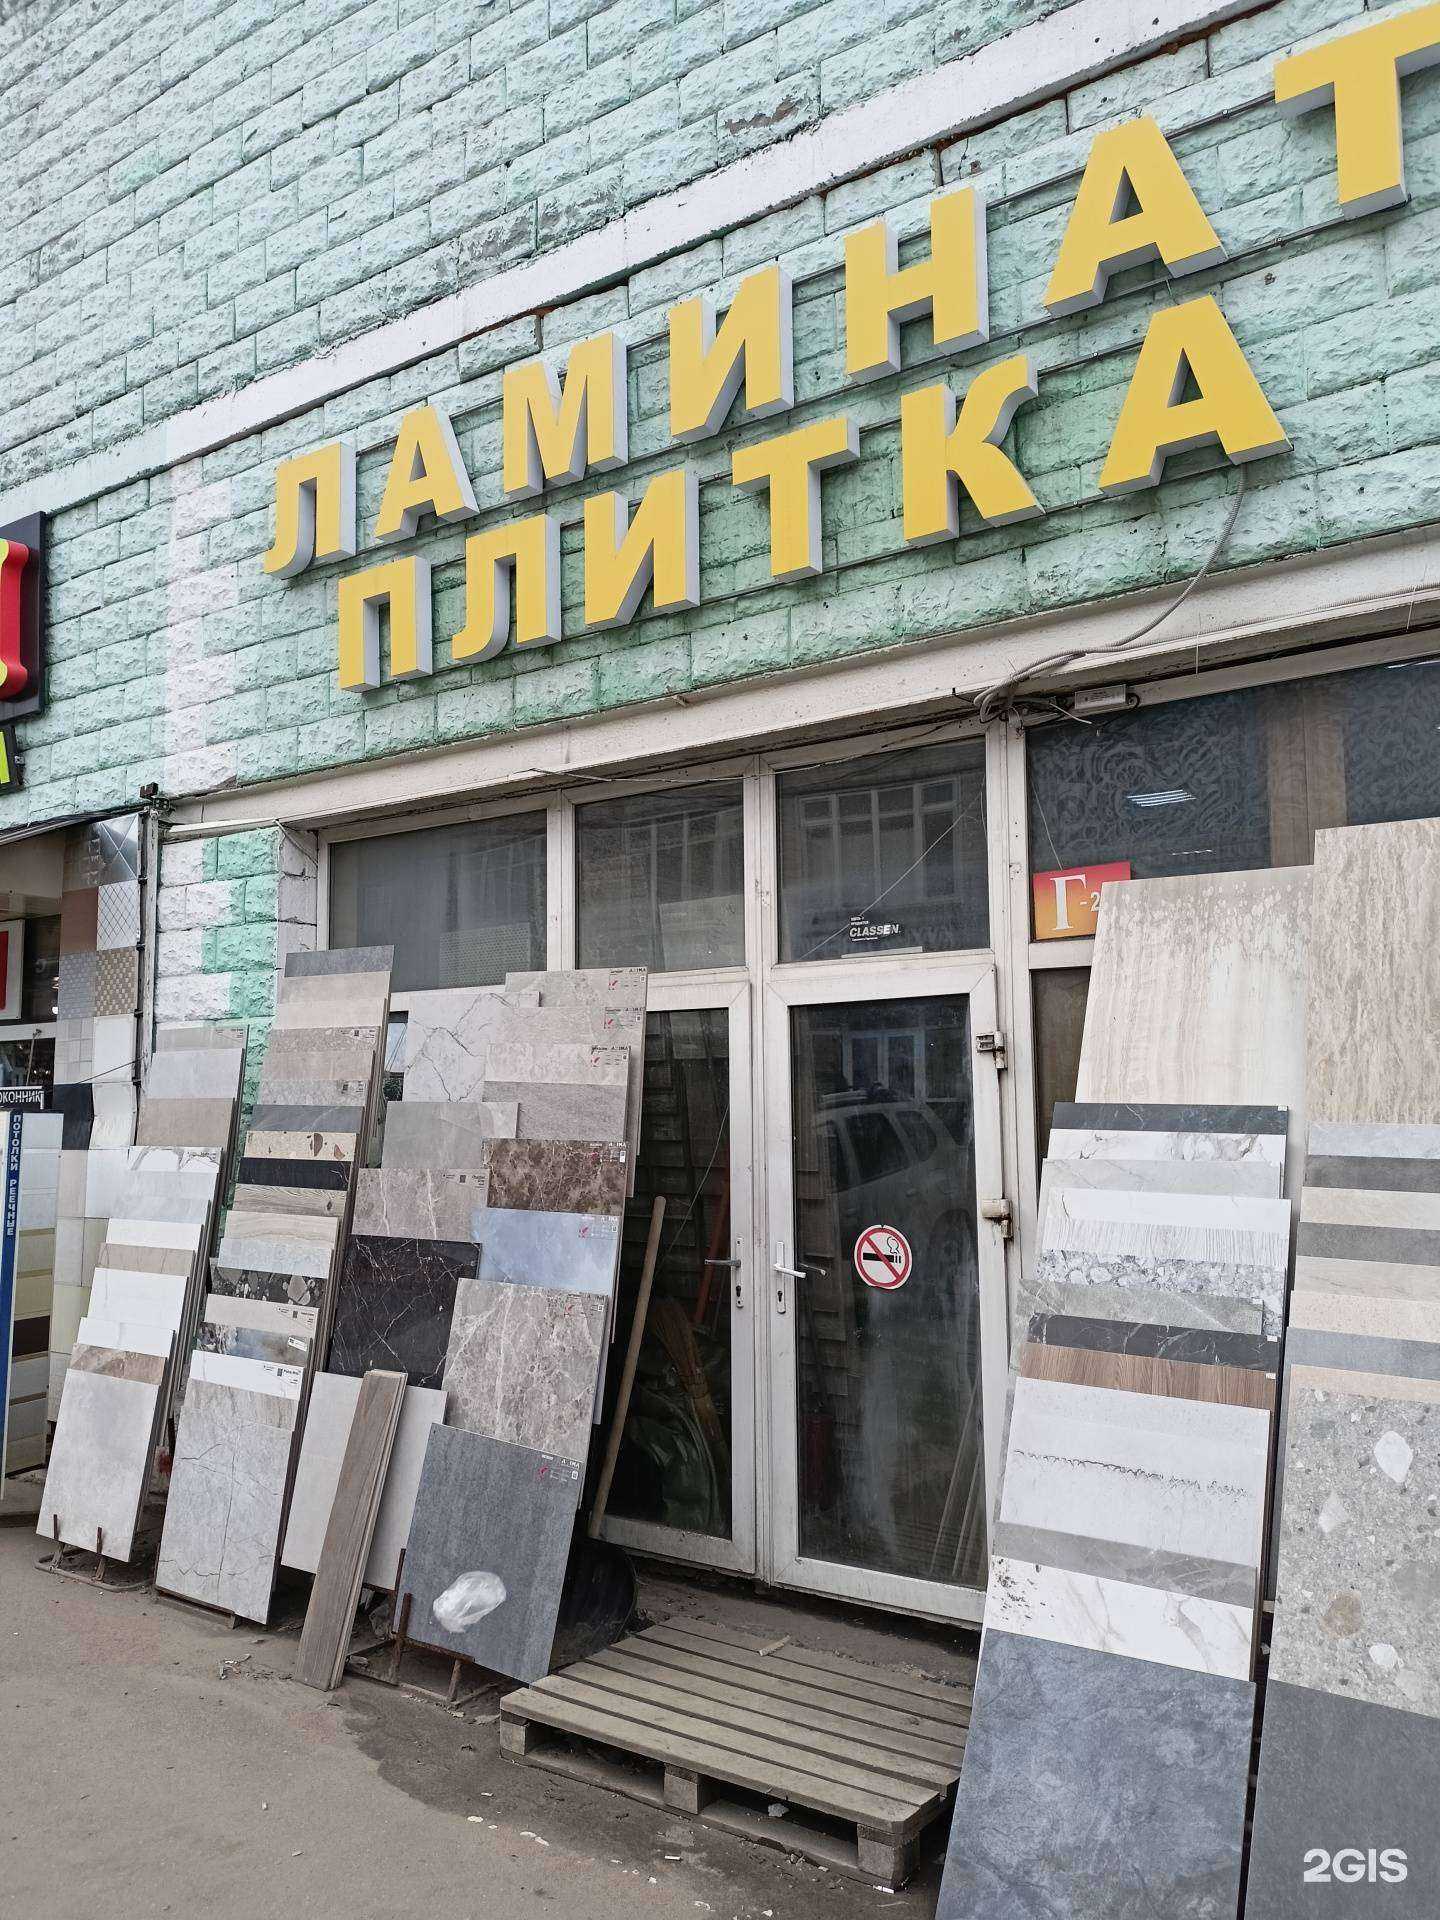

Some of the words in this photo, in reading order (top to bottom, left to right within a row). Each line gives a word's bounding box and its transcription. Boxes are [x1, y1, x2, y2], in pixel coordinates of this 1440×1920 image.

[264, 4, 1440, 579] ЛАМИНАТ
[338, 295, 1291, 692] ПЛИТКА
[850, 924, 900, 938] CLASSEN
[10, 1114, 21, 1171] ПОТОЛКИ
[7, 1179, 17, 1236] РЕЕЧНЫЕ
